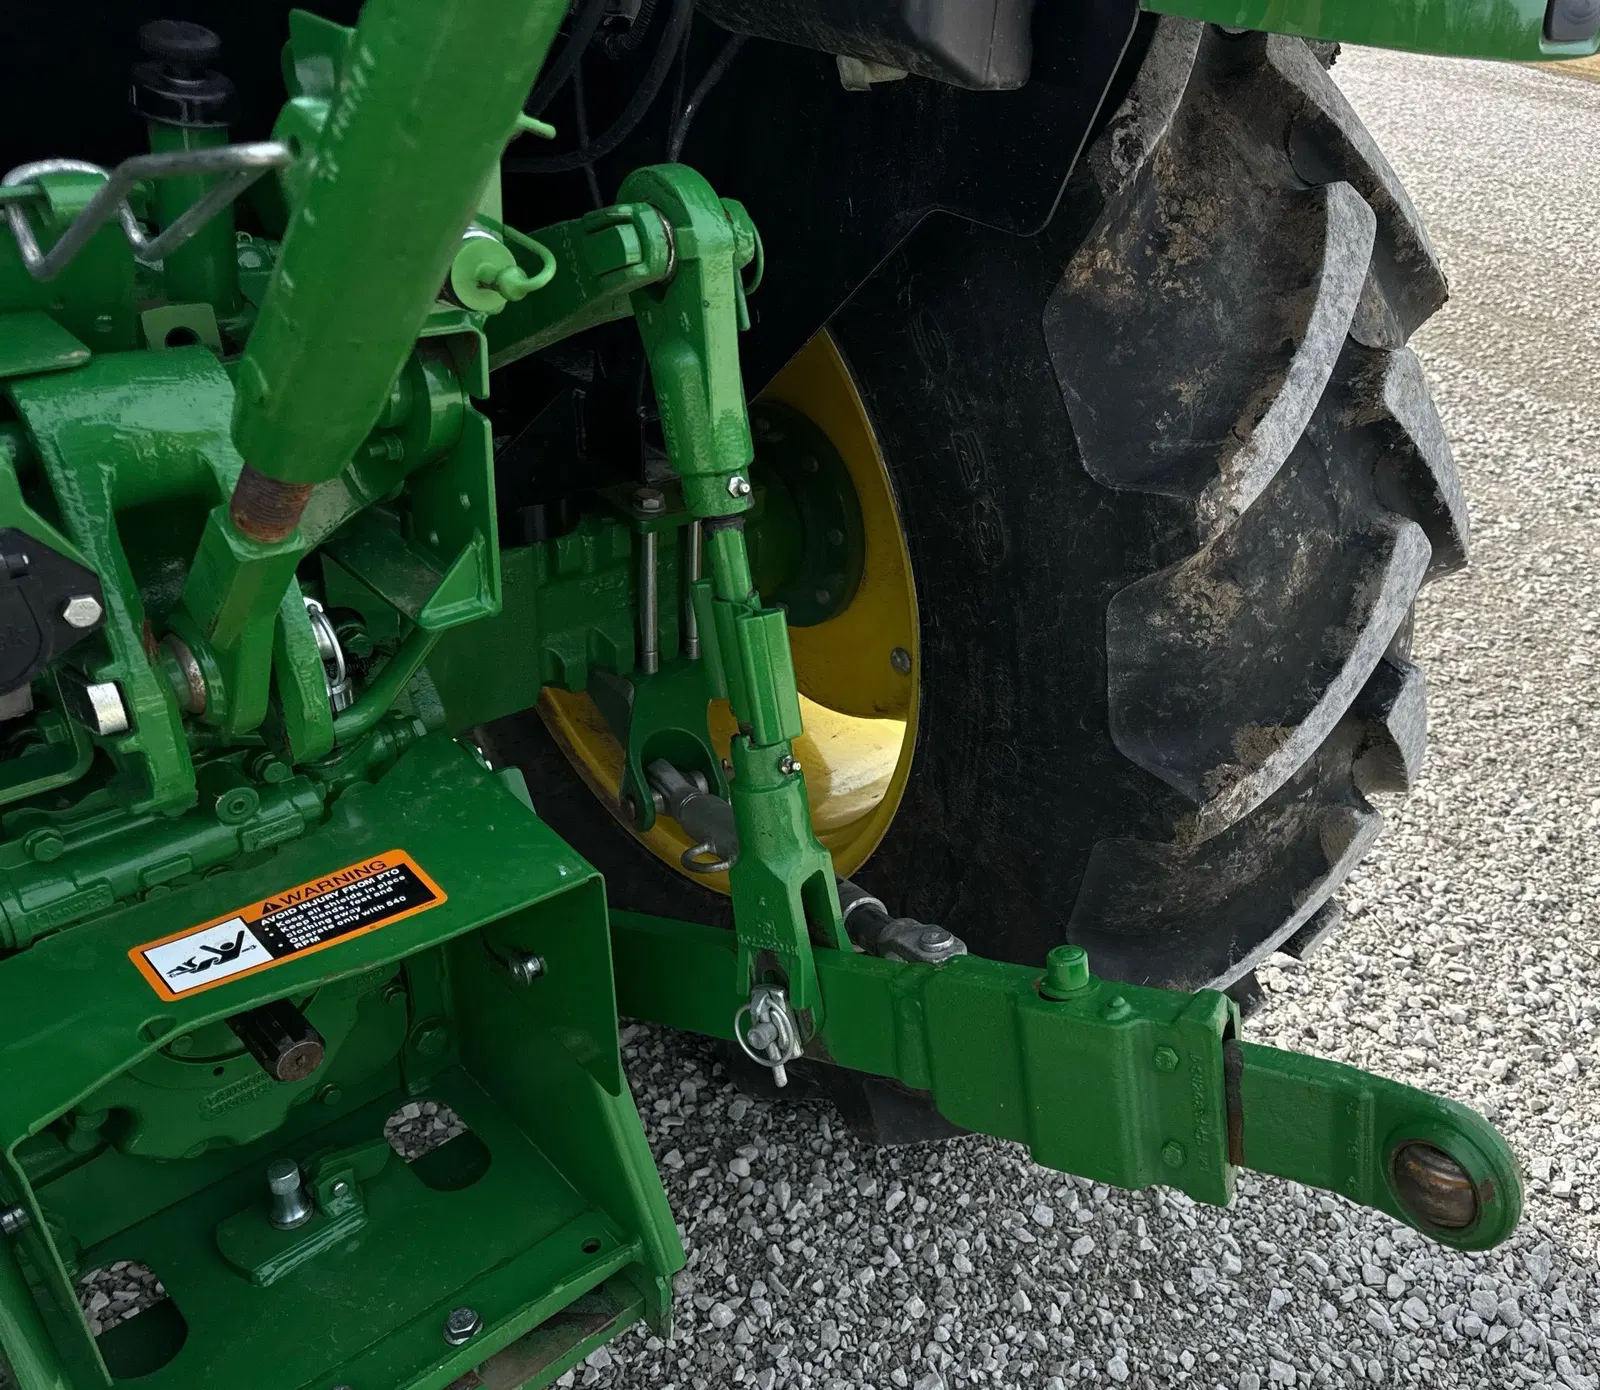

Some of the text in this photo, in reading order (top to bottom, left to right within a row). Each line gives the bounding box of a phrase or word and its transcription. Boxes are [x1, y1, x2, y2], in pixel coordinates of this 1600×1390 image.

[261, 868, 400, 926] AVOID INJURY FROM PTO
[276, 914, 304, 928] Keep
[307, 907, 321, 916] all
[323, 892, 362, 909] shields
[377, 876, 406, 890] place
[279, 861, 387, 905] WARNING
[280, 886, 393, 933] Keep hands, feet and
[286, 906, 361, 938] clothing away
[289, 924, 335, 944] Operate
[336, 914, 360, 926] only
[361, 904, 385, 916] with
[386, 895, 406, 907] 540
[293, 935, 320, 949] RPM
